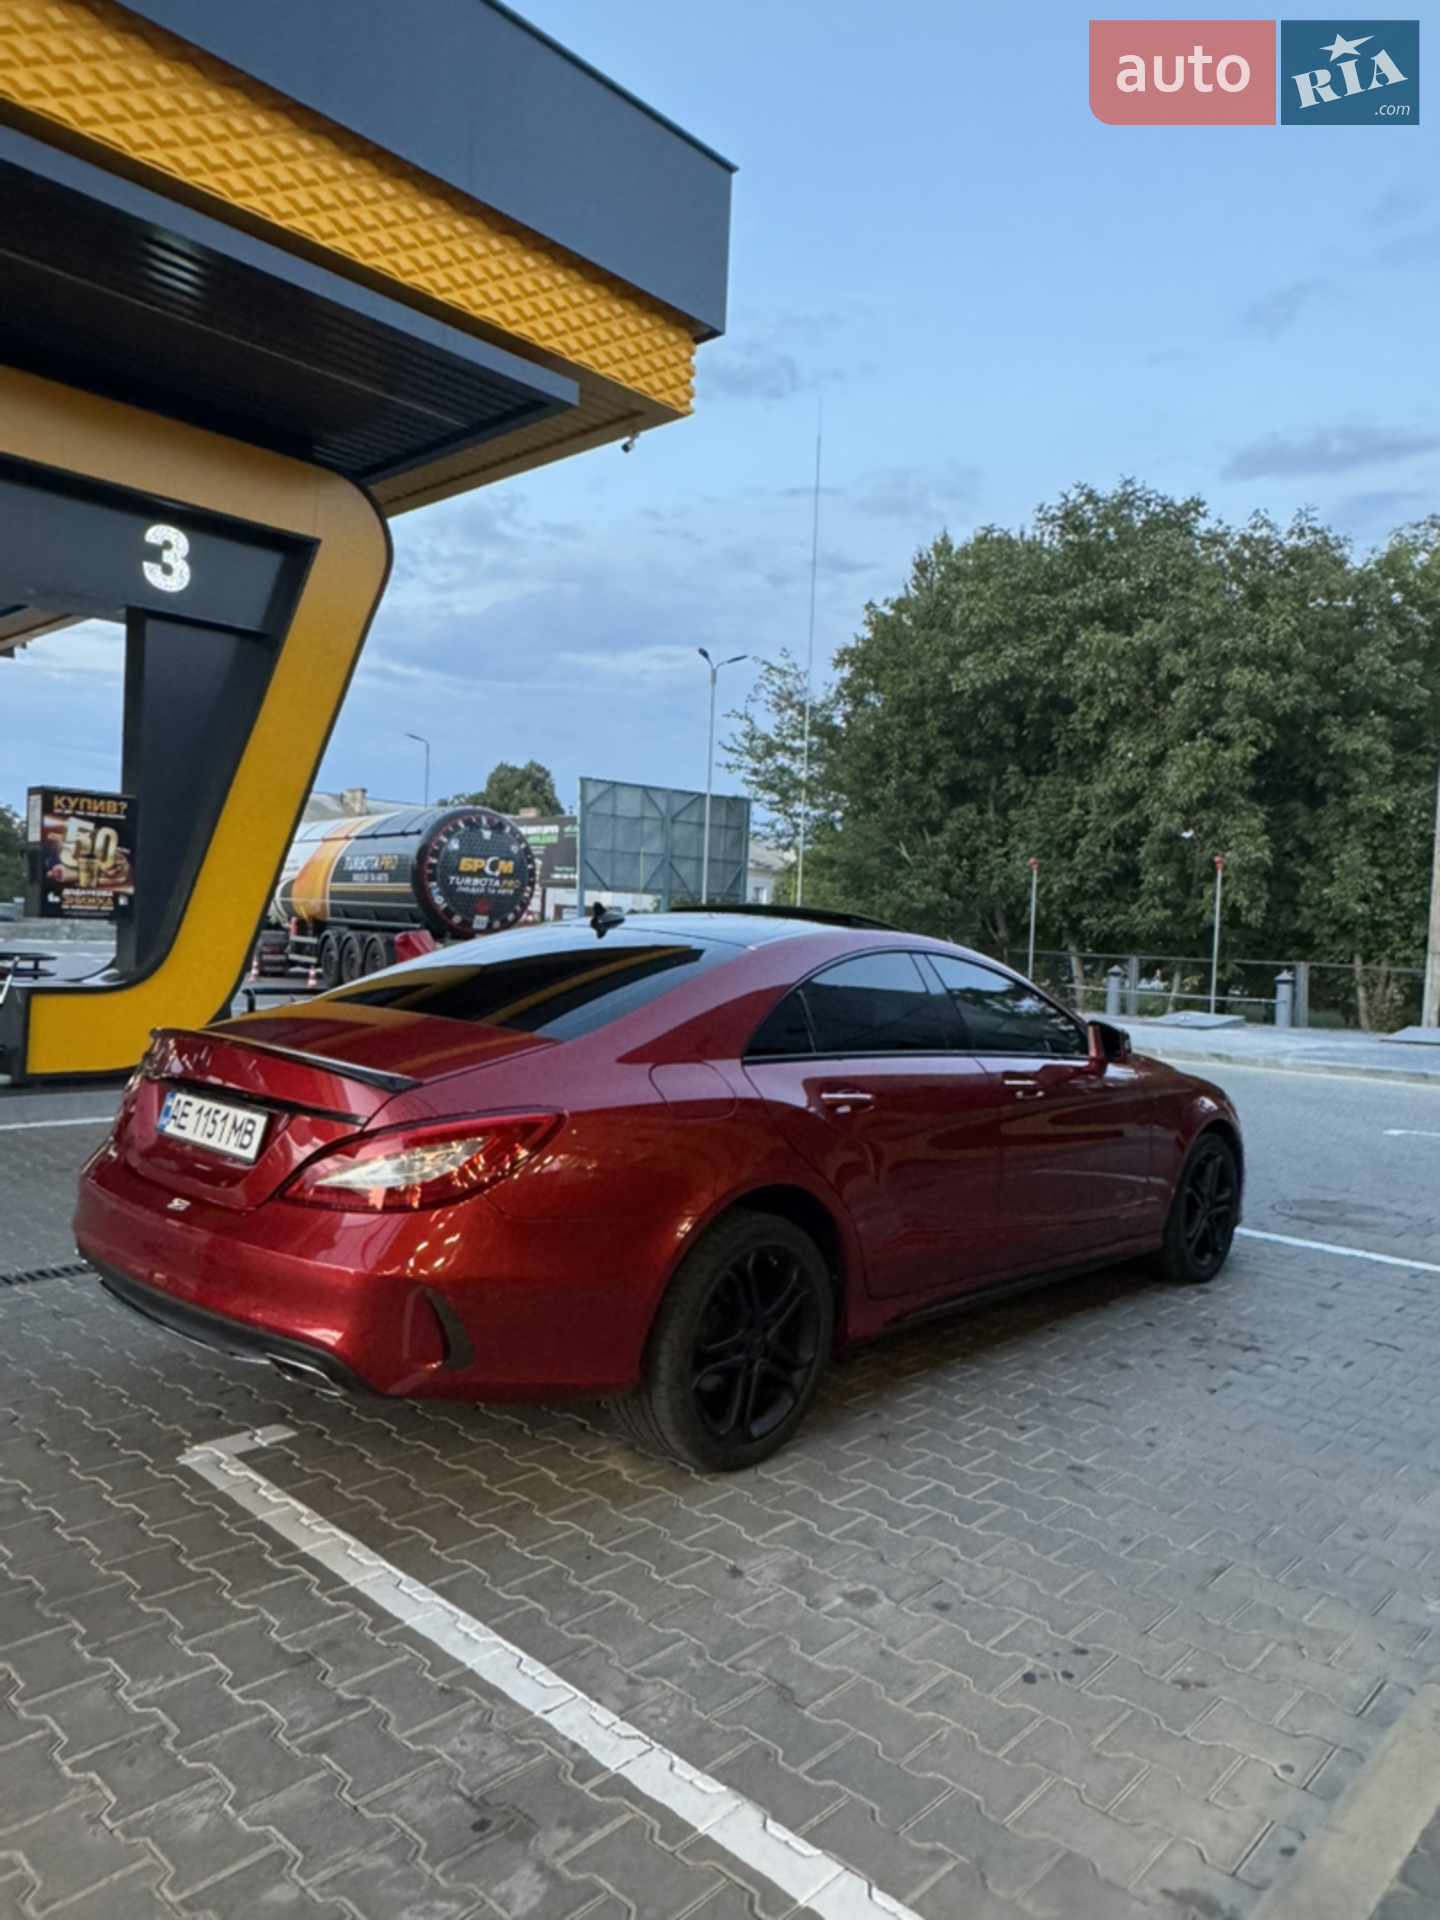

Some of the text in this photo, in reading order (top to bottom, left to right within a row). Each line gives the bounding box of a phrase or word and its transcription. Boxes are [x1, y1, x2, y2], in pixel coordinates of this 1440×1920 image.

[142, 523, 191, 592] 3
[53, 795, 128, 815] КУПИВ?
[60, 816, 119, 871] 50
[171, 1099, 257, 1150] AE 1151 MB
